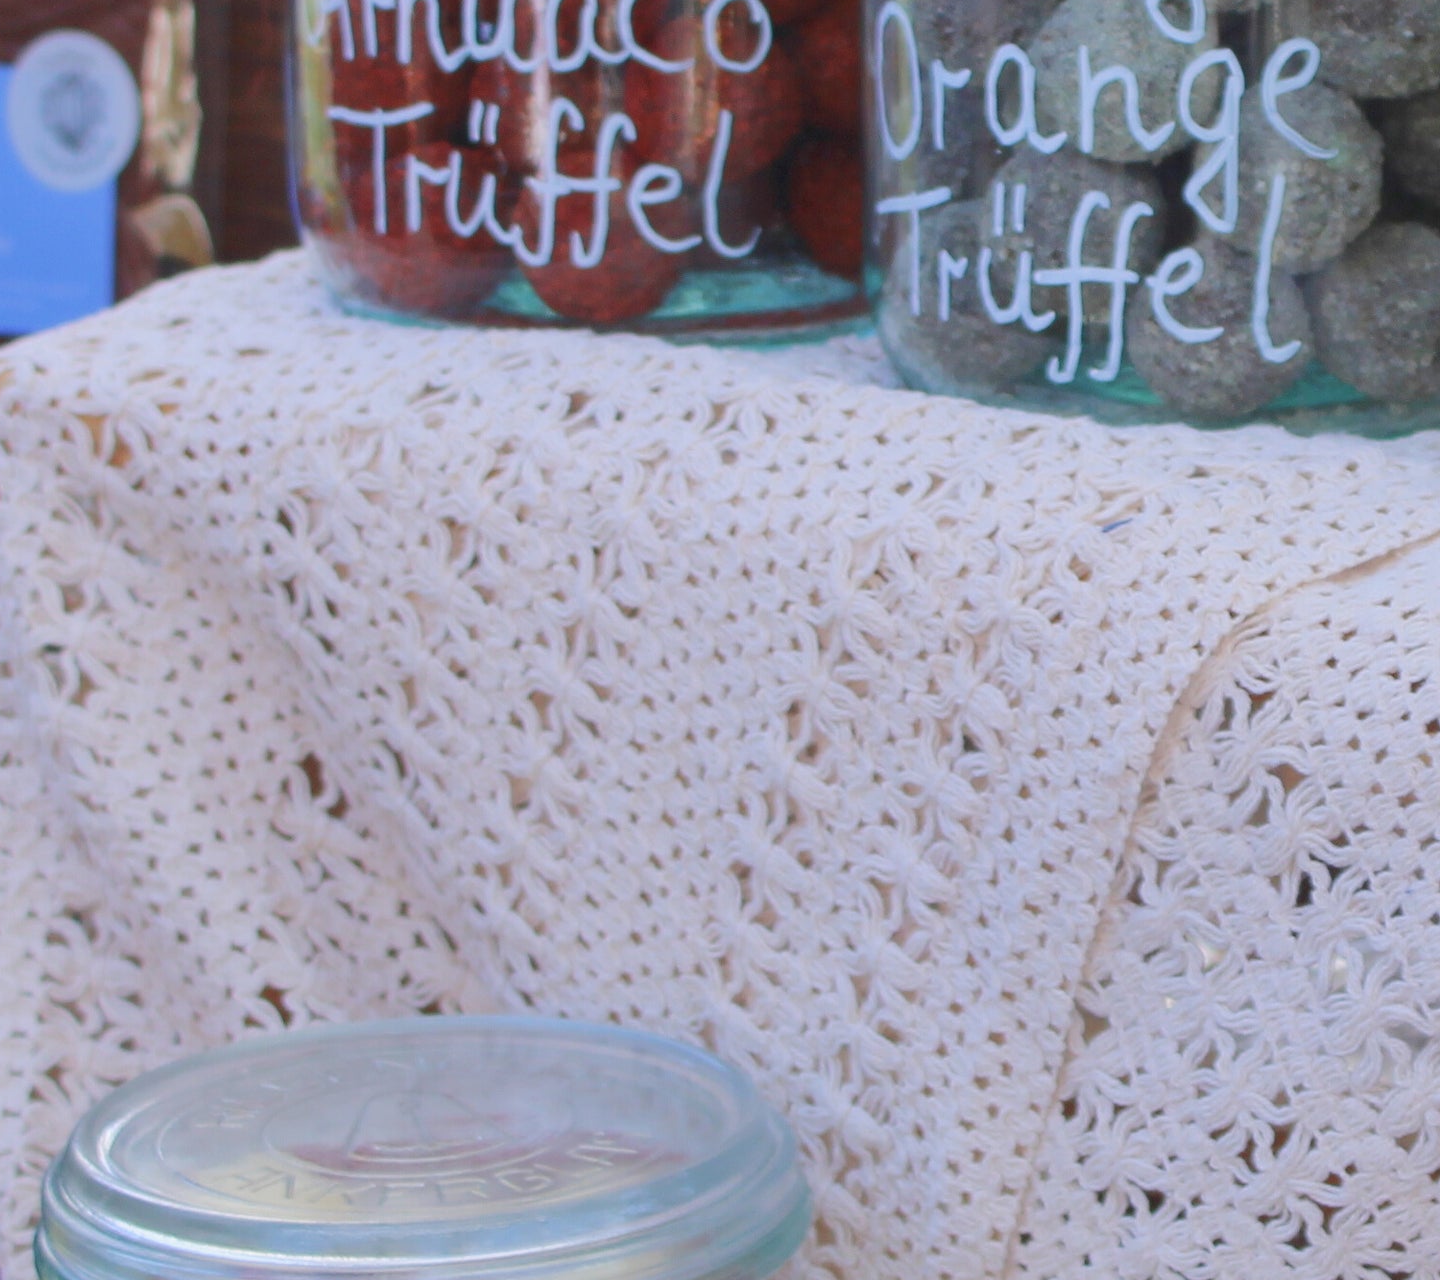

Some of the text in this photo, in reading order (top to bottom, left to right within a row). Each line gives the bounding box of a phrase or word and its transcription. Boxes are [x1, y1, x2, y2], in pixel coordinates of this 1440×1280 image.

[327, 96, 762, 270] Trüffel
[876, 0, 1338, 232] Orange
[876, 174, 1301, 384] Trüffel
